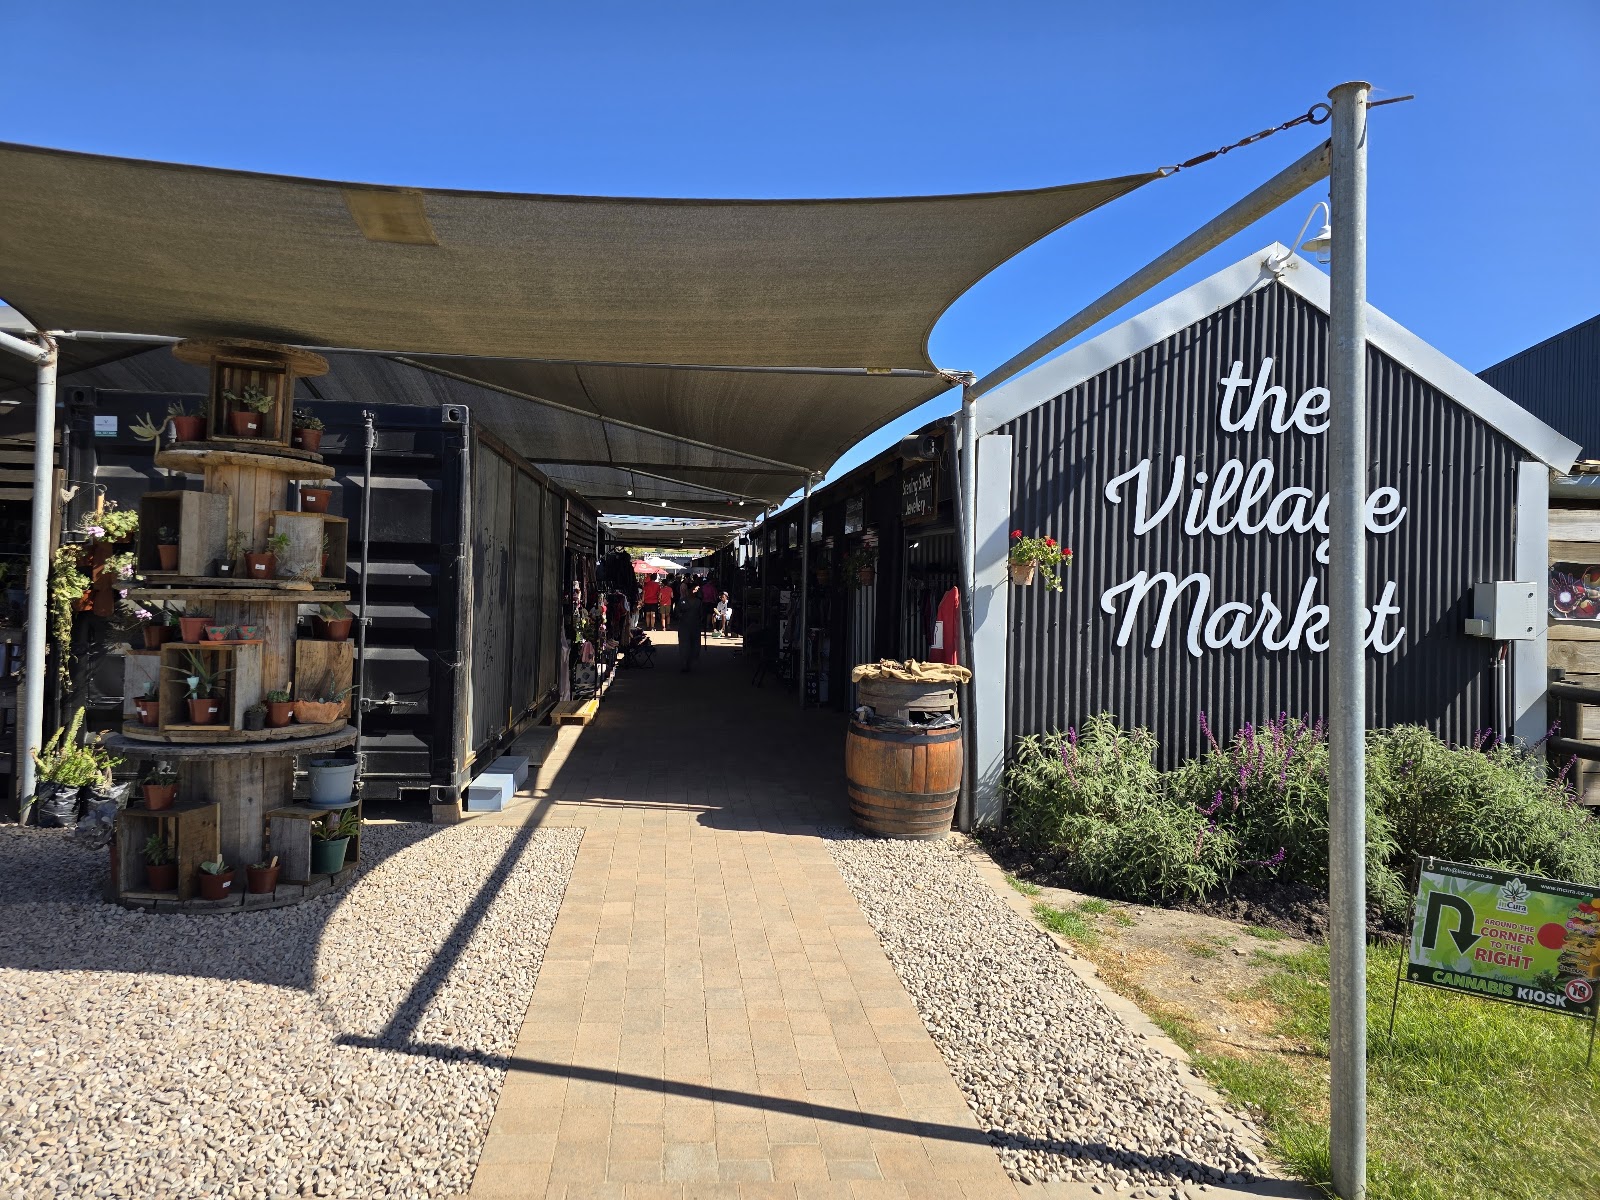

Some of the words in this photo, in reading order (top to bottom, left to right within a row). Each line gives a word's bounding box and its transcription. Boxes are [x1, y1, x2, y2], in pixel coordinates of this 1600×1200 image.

[1220, 357, 1331, 435] the
[1101, 570, 1406, 658] Markt
[1540, 884, 1594, 898] www.incura.co.za
[1498, 900, 1527, 911] inCura
[1485, 918, 1518, 930] AROUND
[1520, 924, 1535, 933] THE
[1480, 926, 1535, 946] CORNER
[1490, 940, 1503, 949] TO
[1505, 943, 1523, 953] THE
[1474, 947, 1534, 970] RIGHT
[1432, 970, 1514, 997] CANNABIS
[1517, 987, 1567, 1008] KIOSK
